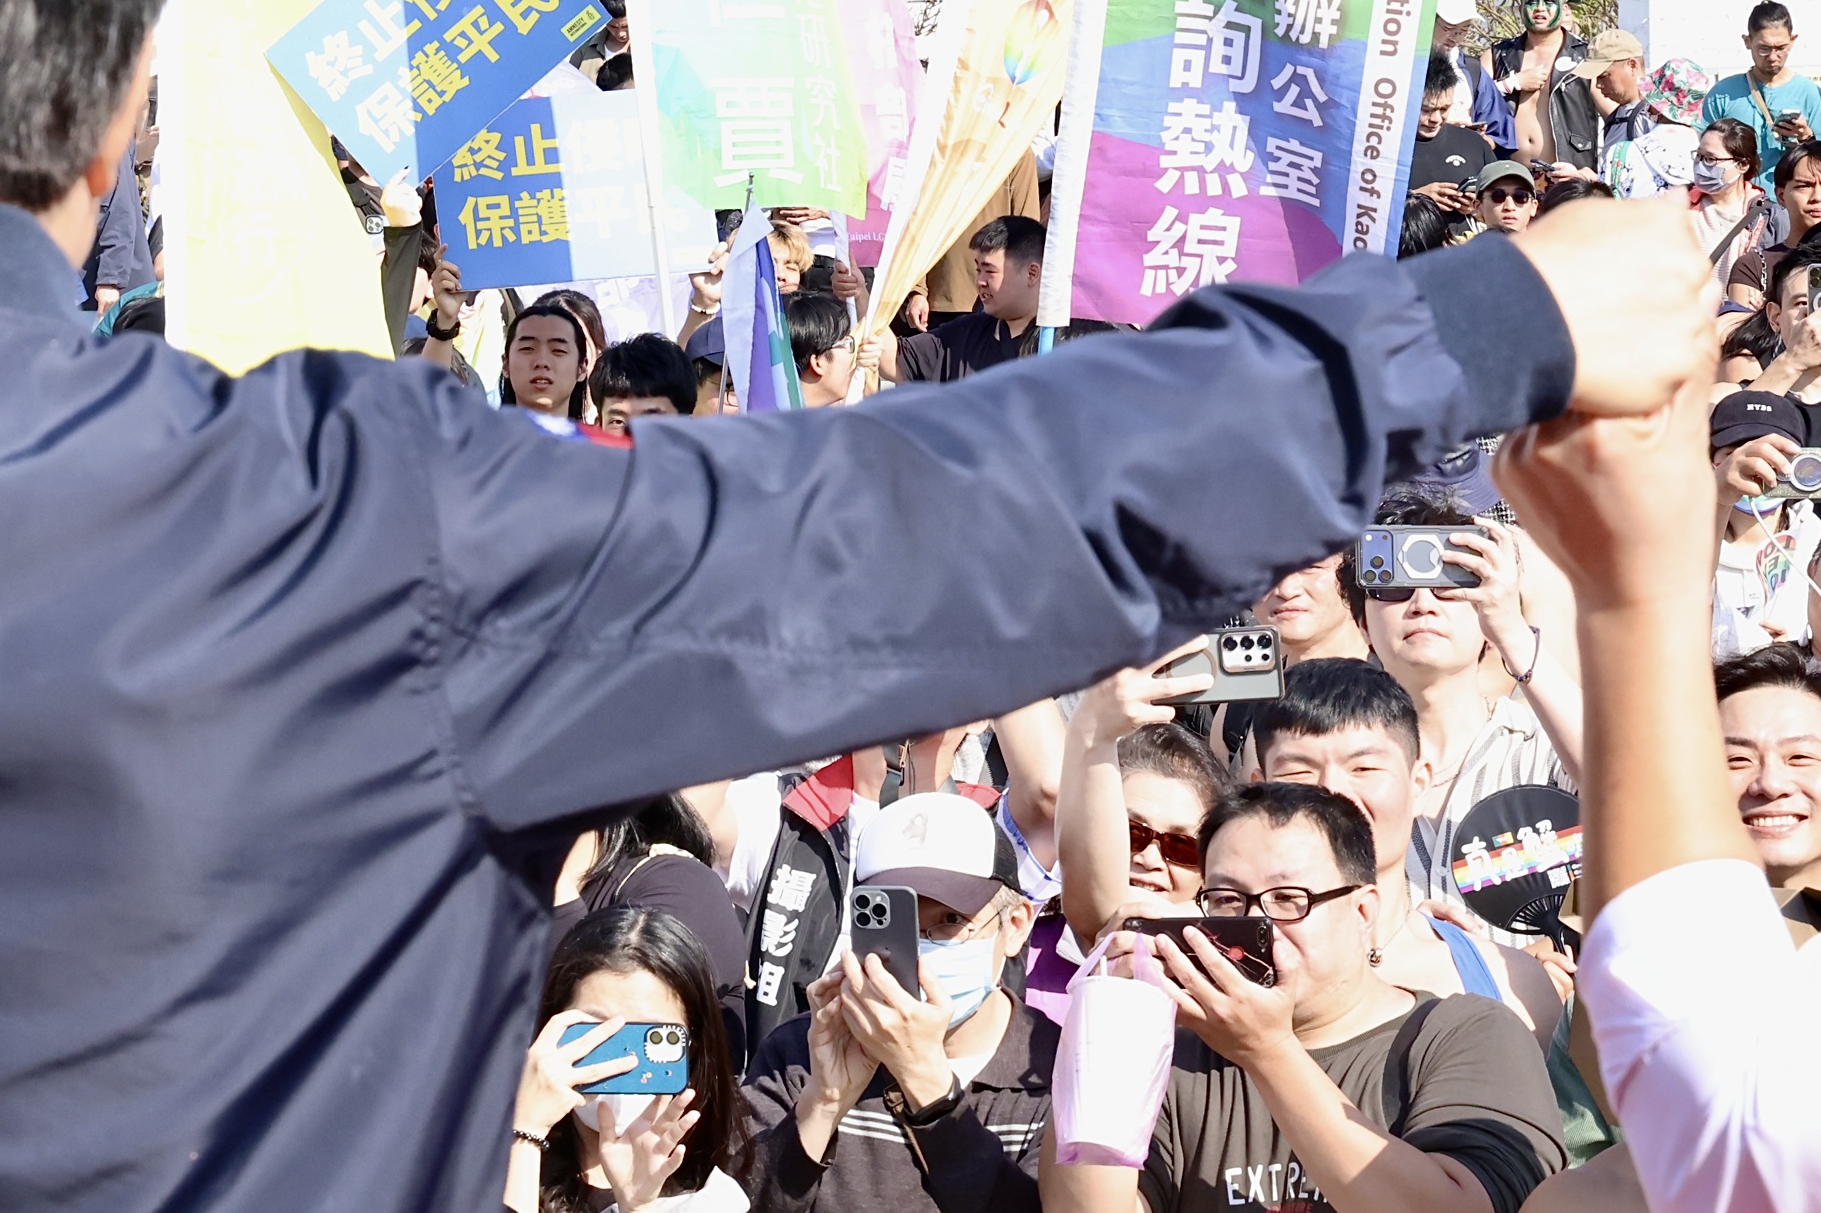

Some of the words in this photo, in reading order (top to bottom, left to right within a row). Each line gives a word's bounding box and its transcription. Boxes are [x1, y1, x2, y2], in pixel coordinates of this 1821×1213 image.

[566, 17, 585, 34] AMNESTY
[1369, 77, 1399, 147] Office
[1361, 152, 1385, 184] of
